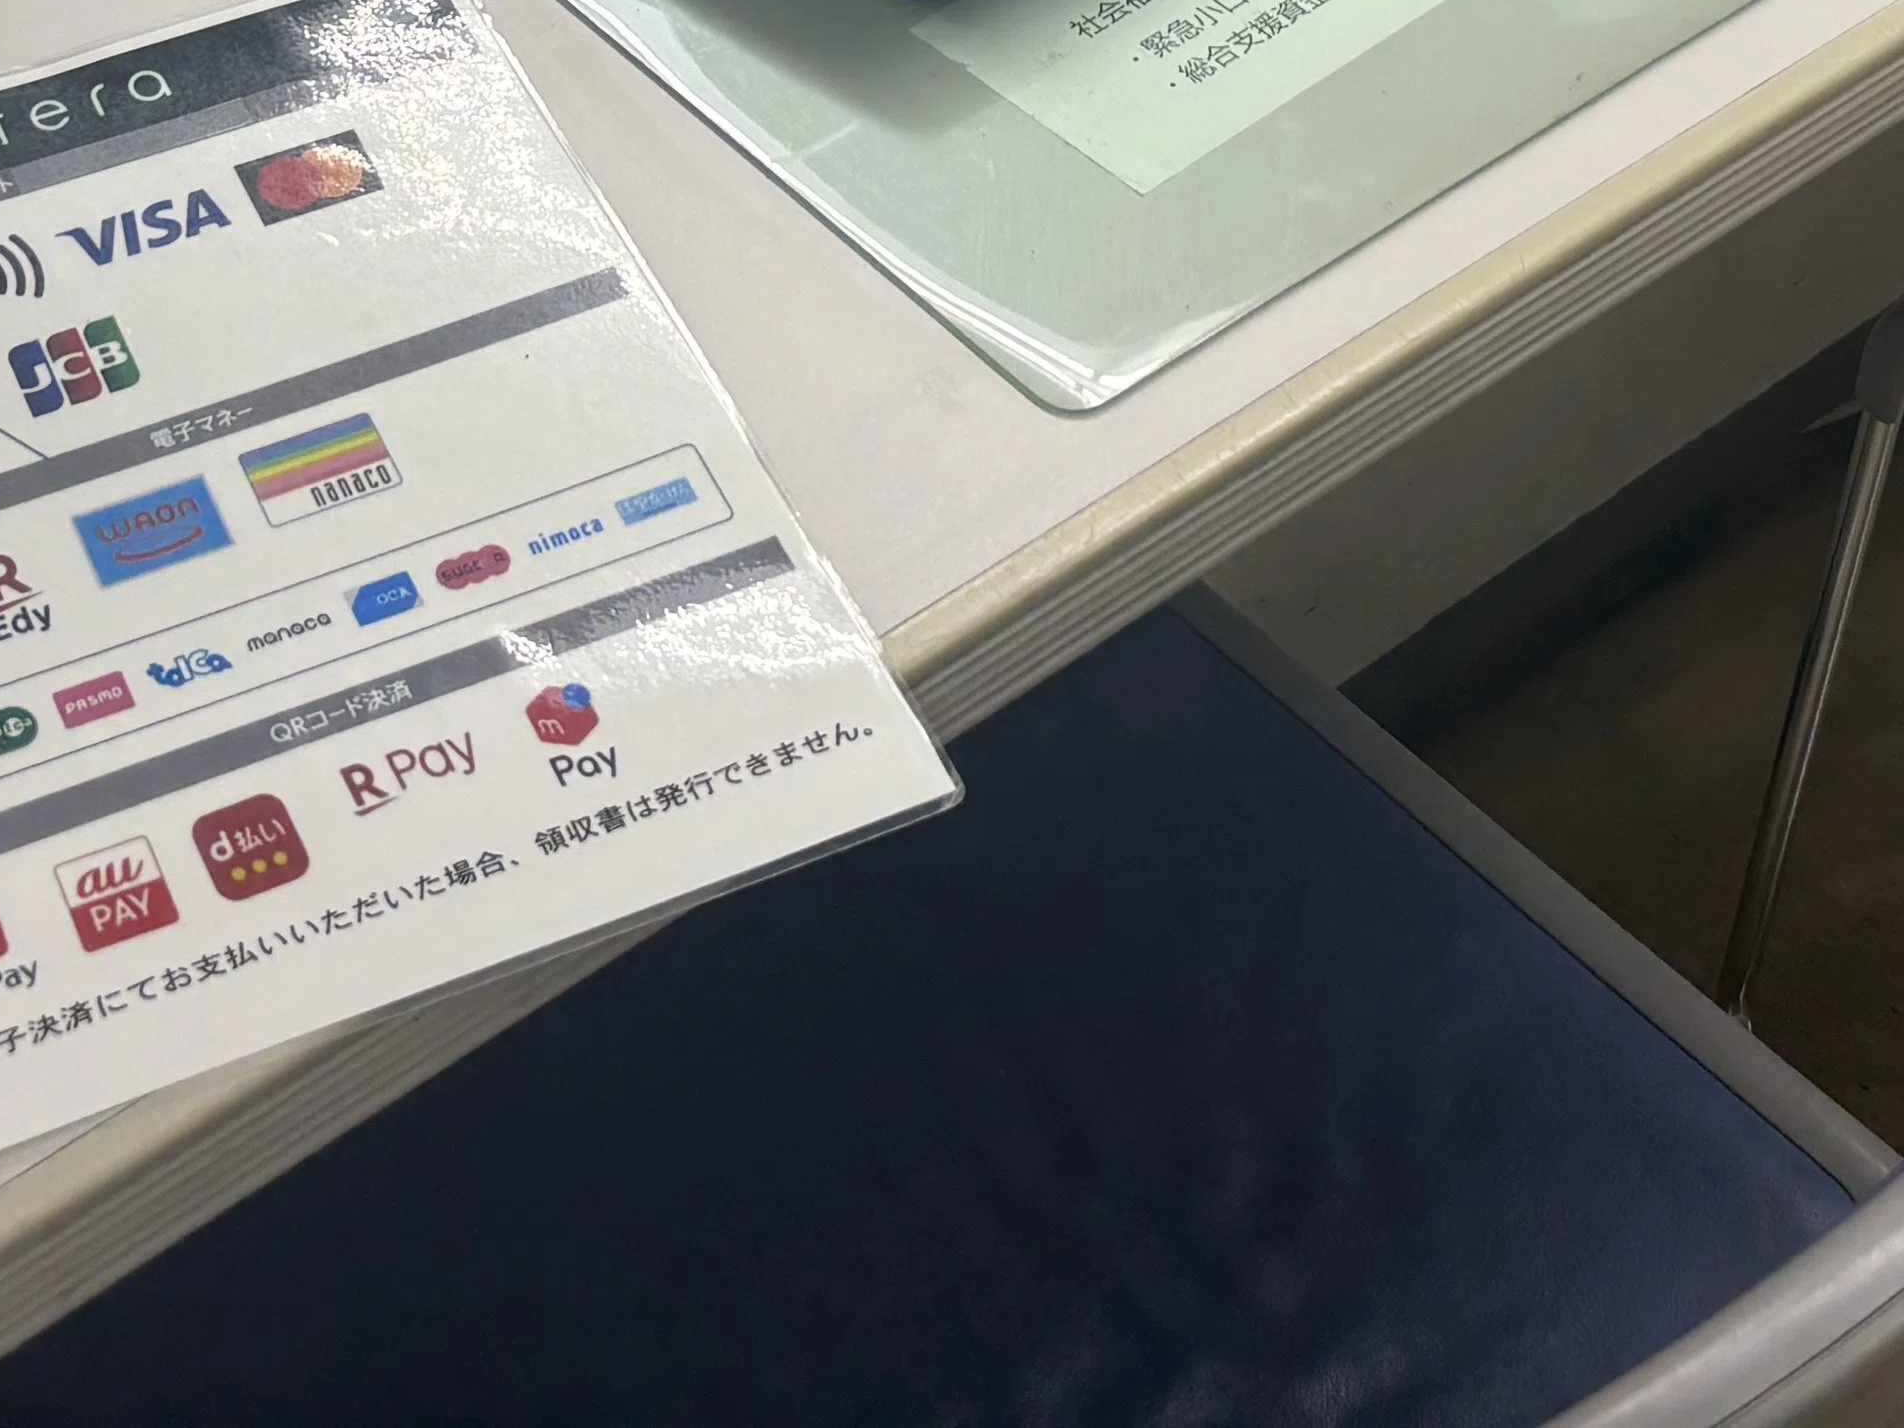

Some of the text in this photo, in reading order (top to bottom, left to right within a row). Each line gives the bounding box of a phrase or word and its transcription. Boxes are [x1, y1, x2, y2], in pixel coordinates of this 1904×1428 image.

[56, 187, 232, 268] VISA
[148, 404, 255, 451] 電子マネー
[309, 463, 394, 508] nanaco
[64, 685, 125, 715] PASMO
[245, 612, 333, 653] manaca
[527, 517, 605, 556] nimoca
[267, 679, 414, 745] QRコード決済
[338, 730, 479, 816] R Pay
[549, 743, 619, 789] Pay
[209, 815, 287, 865] d払い
[73, 849, 147, 899] au
[89, 889, 154, 935] PAY
